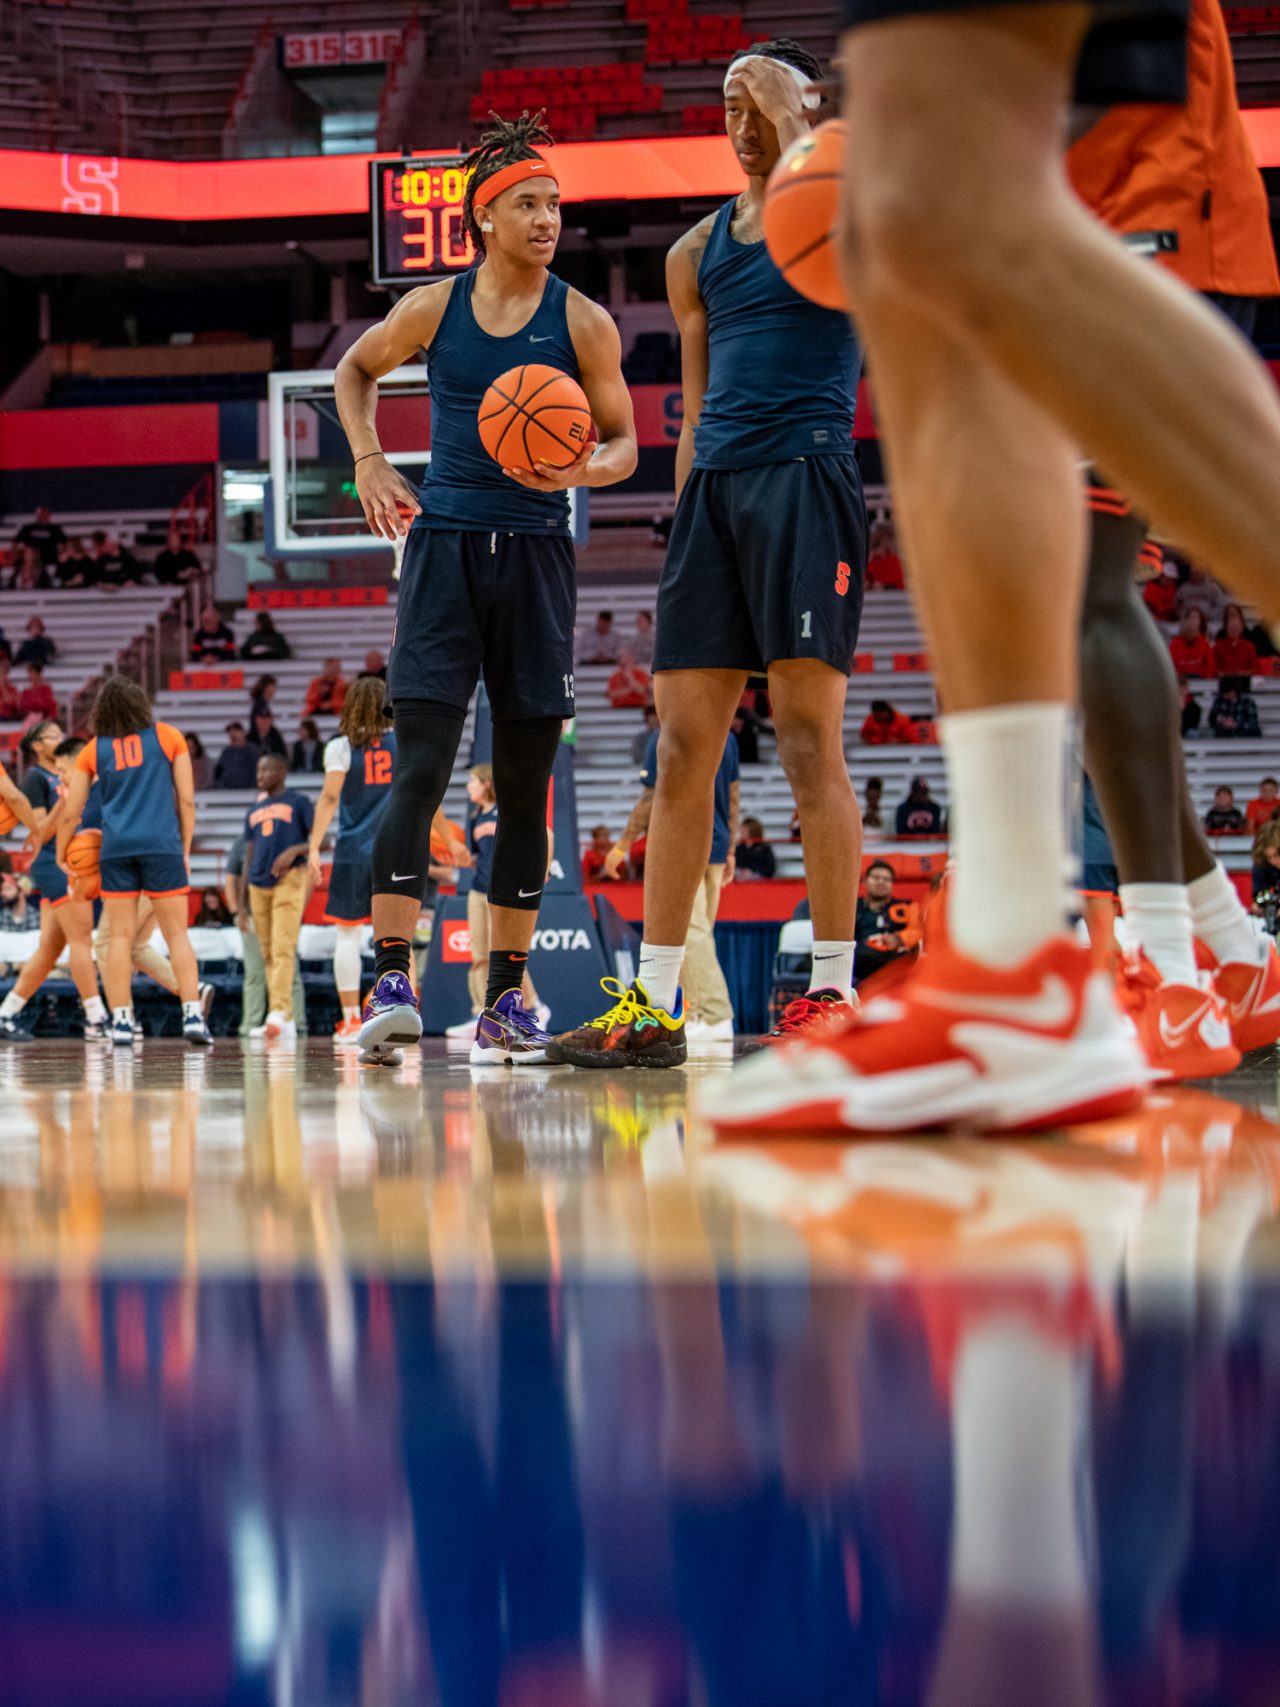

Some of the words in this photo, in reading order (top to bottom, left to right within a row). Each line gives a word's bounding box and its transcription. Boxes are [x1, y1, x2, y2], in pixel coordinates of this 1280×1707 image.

[287, 38, 339, 63] 315
[402, 206, 476, 268] 30
[801, 610, 812, 638] 1
[112, 734, 143, 771] 10
[365, 750, 392, 784] 12
